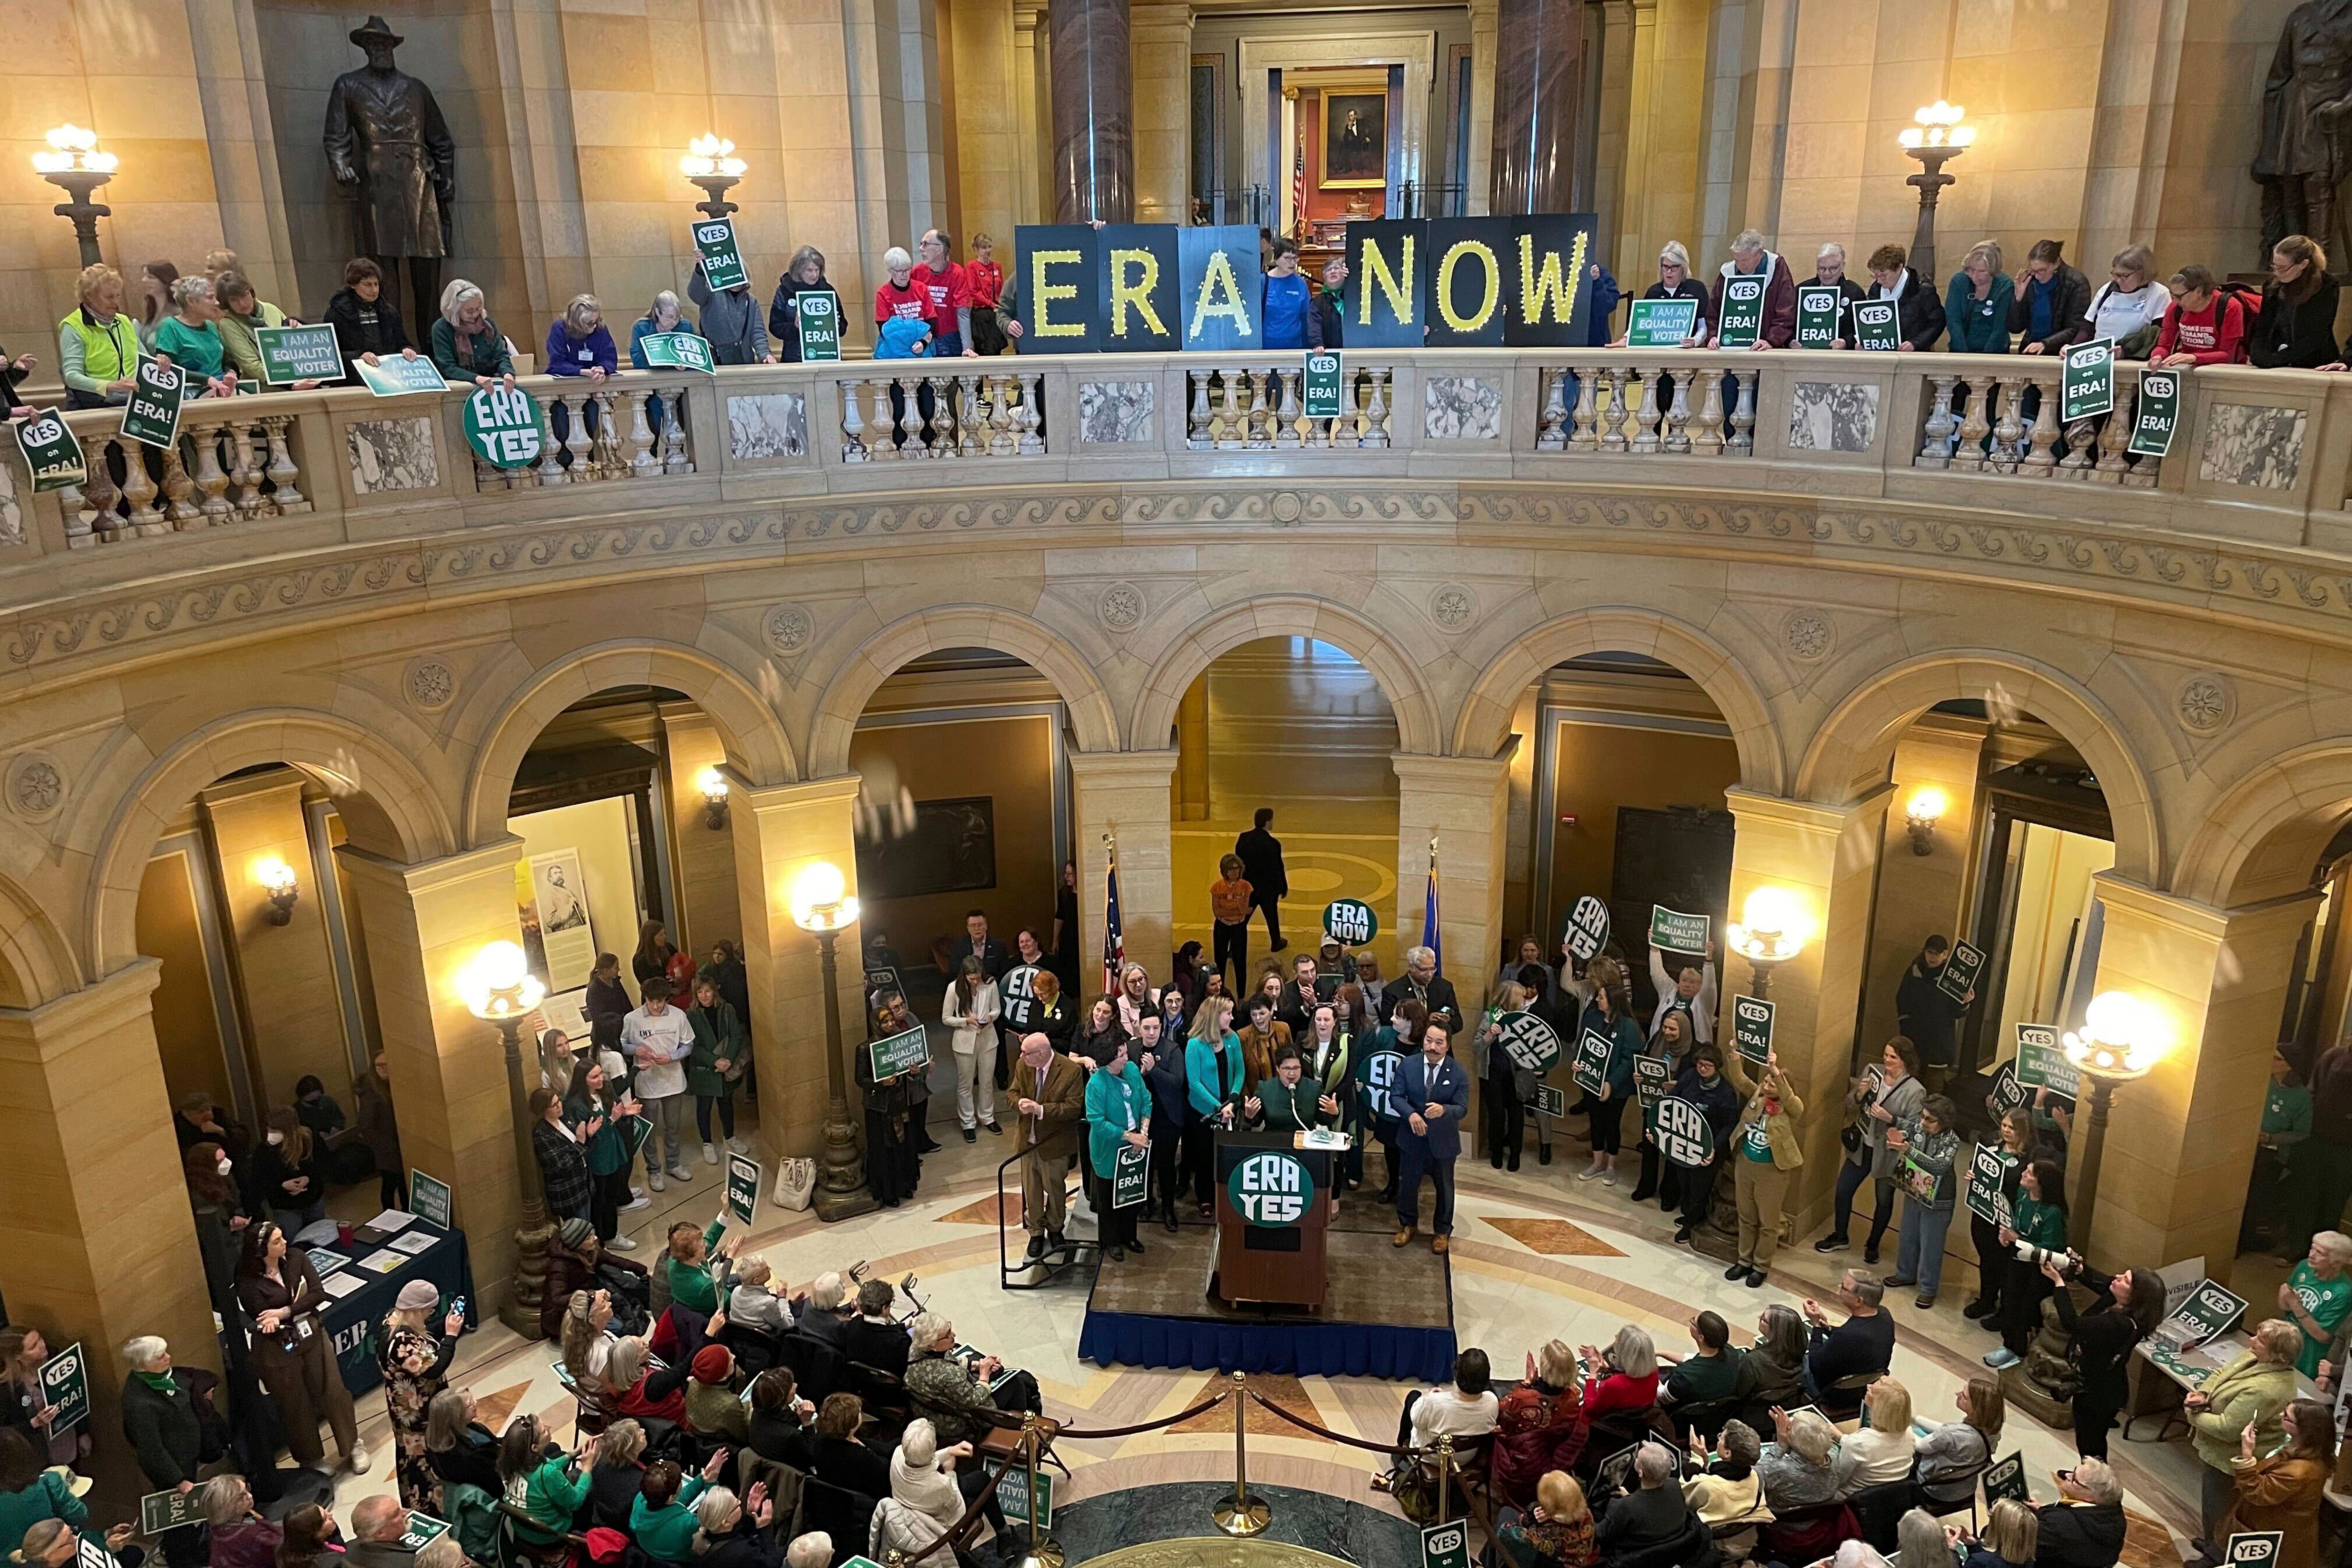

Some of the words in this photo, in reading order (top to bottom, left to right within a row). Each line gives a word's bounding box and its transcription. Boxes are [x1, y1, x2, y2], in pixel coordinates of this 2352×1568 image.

[701, 229, 725, 241] YES
[706, 253, 736, 270] ERA!
[1032, 248, 1252, 339] ERA
[1358, 230, 1587, 332] NOW
[1733, 286, 1756, 297] YES
[805, 301, 828, 312] YES
[1653, 308, 1655, 316] I
[1657, 307, 1675, 316] AM
[1676, 307, 1690, 316] AN
[1807, 298, 1830, 309] YES
[1639, 319, 1689, 329] EQUALITY
[1724, 316, 1756, 328] ERA!
[1863, 310, 1888, 321] YES
[283, 334, 288, 346] I
[290, 334, 309, 345] AM
[312, 332, 329, 345] AN
[805, 331, 834, 342] ERA!
[1653, 330, 1686, 340] VOTER
[1802, 328, 1832, 340] ERA!
[674, 336, 701, 353] ERA
[1863, 338, 1895, 350] ERA!
[273, 346, 332, 361] EQUALITY
[674, 349, 704, 365] YES
[2074, 350, 2103, 365] YES
[294, 360, 337, 373] VOTER
[1312, 361, 1333, 370] YES
[147, 366, 174, 387] YES
[399, 378, 442, 387] VOTER
[152, 391, 162, 399] on
[1309, 387, 1336, 399] ERA!
[2069, 378, 2106, 398] ERA!
[2148, 382, 2170, 395] YES
[134, 400, 172, 424] ERA!
[473, 385, 532, 428] ERA
[2141, 415, 2171, 431] ERA!
[26, 424, 58, 443] YES
[477, 428, 540, 463] YES
[38, 457, 78, 479] ERA!
[1331, 902, 1369, 925] ERA
[1572, 896, 1606, 938] ERA
[1331, 921, 1368, 941] NOW
[1658, 923, 1703, 939] EQUALITY
[1673, 918, 1687, 928] AM
[1690, 920, 1704, 929] AN
[1564, 919, 1597, 960] YES
[1671, 936, 1702, 948] VOTER
[1960, 949, 1976, 964] YES
[1008, 967, 1039, 998] ER
[1947, 967, 1969, 987] ERA!
[1003, 996, 1031, 1024] YE
[1742, 1005, 1765, 1020] YES
[895, 1038, 909, 1049] AM
[910, 1033, 922, 1044] AN
[1512, 1015, 1558, 1060] ERA
[1737, 1030, 1766, 1047] ERA!
[2026, 1033, 2051, 1043] YES
[882, 1042, 922, 1063] EQUALITY
[1498, 1024, 1542, 1069] YES
[1588, 1039, 1604, 1056] YES
[896, 1052, 925, 1067] VOTER
[1370, 1054, 1401, 1087] ER
[1580, 1060, 1601, 1080] ERA!
[1642, 1063, 1662, 1075] YES
[2006, 1083, 2018, 1101] YES
[1658, 1099, 1702, 1142] ERA
[1655, 1126, 1704, 1166] YES
[1242, 1155, 1300, 1192] ERA
[1980, 1156, 1998, 1175] YES
[1118, 1173, 1143, 1189] ERA!
[1971, 1180, 1991, 1201] ERA
[1238, 1194, 1303, 1222] YES
[1993, 1191, 2010, 1215] ERA
[1992, 1206, 2012, 1228] YES
[2204, 1291, 2231, 1312] YES
[2178, 1310, 2214, 1333] ERA!
[49, 1359, 74, 1381] YES
[61, 1386, 82, 1410] RA!
[1990, 1465, 2015, 1482] YES
[1432, 1534, 1458, 1551] YES
[2239, 1544, 2267, 1558] YES
